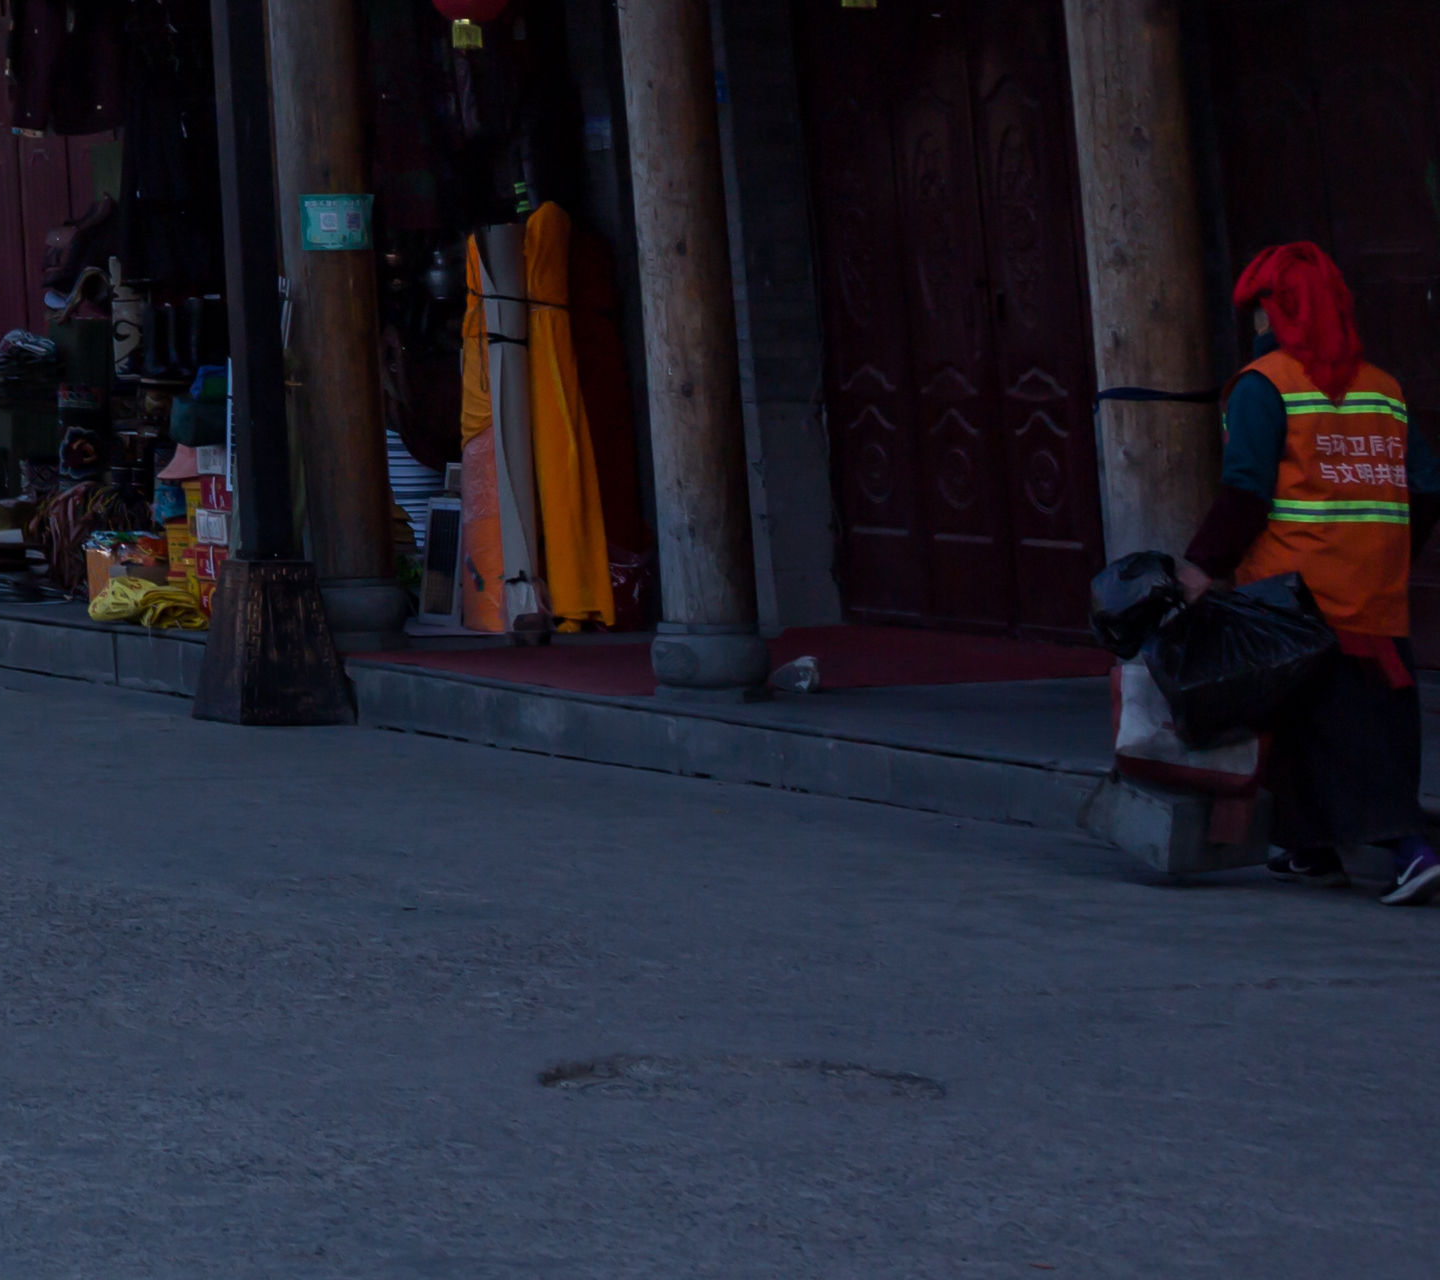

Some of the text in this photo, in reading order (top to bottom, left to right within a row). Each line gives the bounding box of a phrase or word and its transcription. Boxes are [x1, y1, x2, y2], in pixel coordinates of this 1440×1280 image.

[1315, 433, 1404, 459] 与环卫同行
[1319, 462, 1408, 488] 与文明共进
